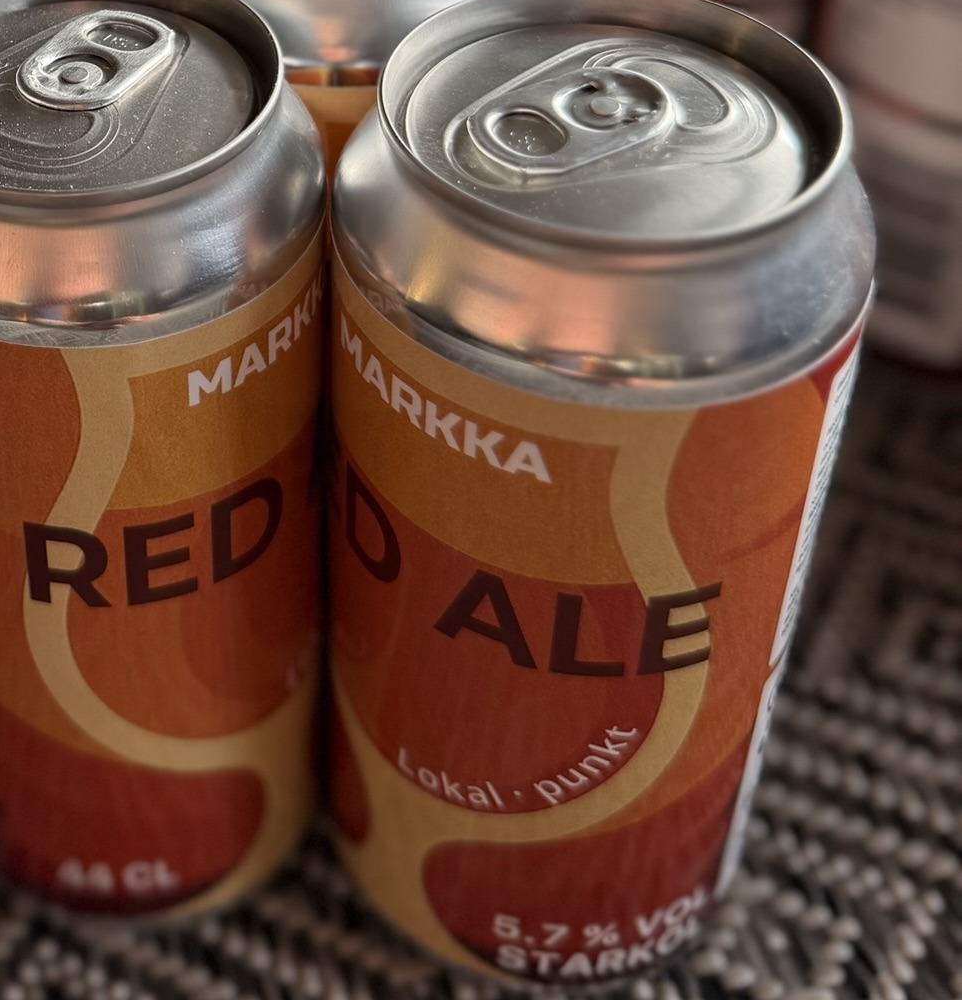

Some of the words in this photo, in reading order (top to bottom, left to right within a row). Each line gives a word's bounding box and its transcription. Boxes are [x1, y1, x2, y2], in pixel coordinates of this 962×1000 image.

[341, 311, 552, 484] MARKKA
[23, 477, 284, 608] RED
[434, 569, 722, 677] ALE
[398, 748, 505, 810] Lokal
[536, 724, 639, 806] punkt
[493, 913, 570, 948] 5.7
[583, 921, 620, 947] %
